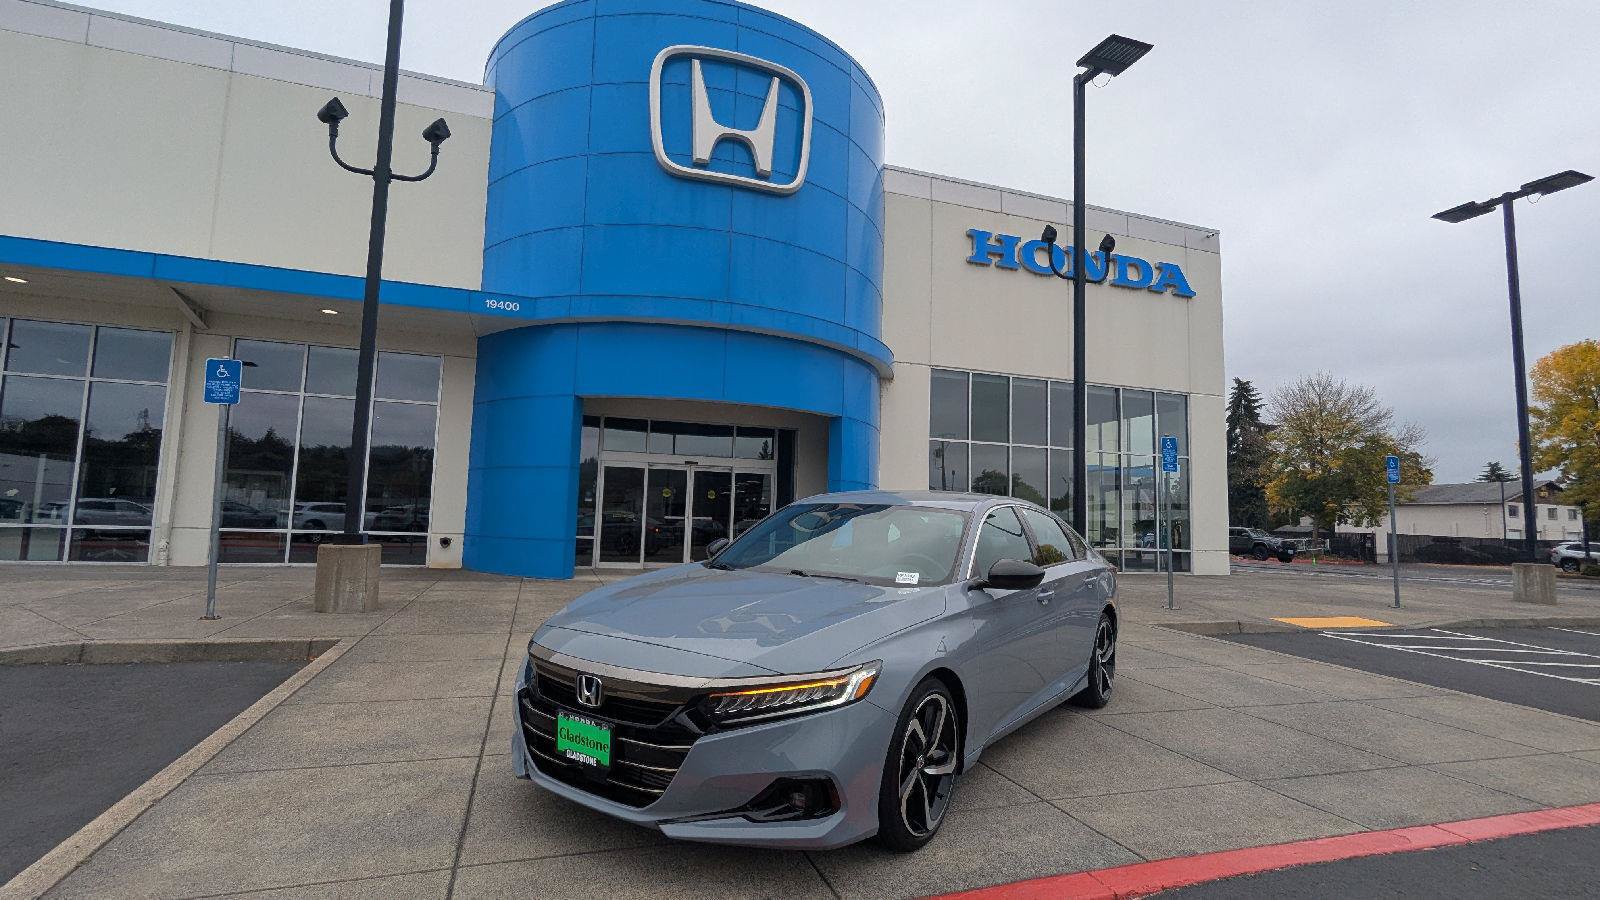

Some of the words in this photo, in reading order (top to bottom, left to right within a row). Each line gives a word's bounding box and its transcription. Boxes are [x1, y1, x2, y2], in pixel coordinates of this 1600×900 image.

[966, 228, 1197, 298] HONDA
[485, 299, 520, 311] 19400
[559, 727, 609, 753] Gladstone
[566, 749, 597, 767] GLADSTONE
